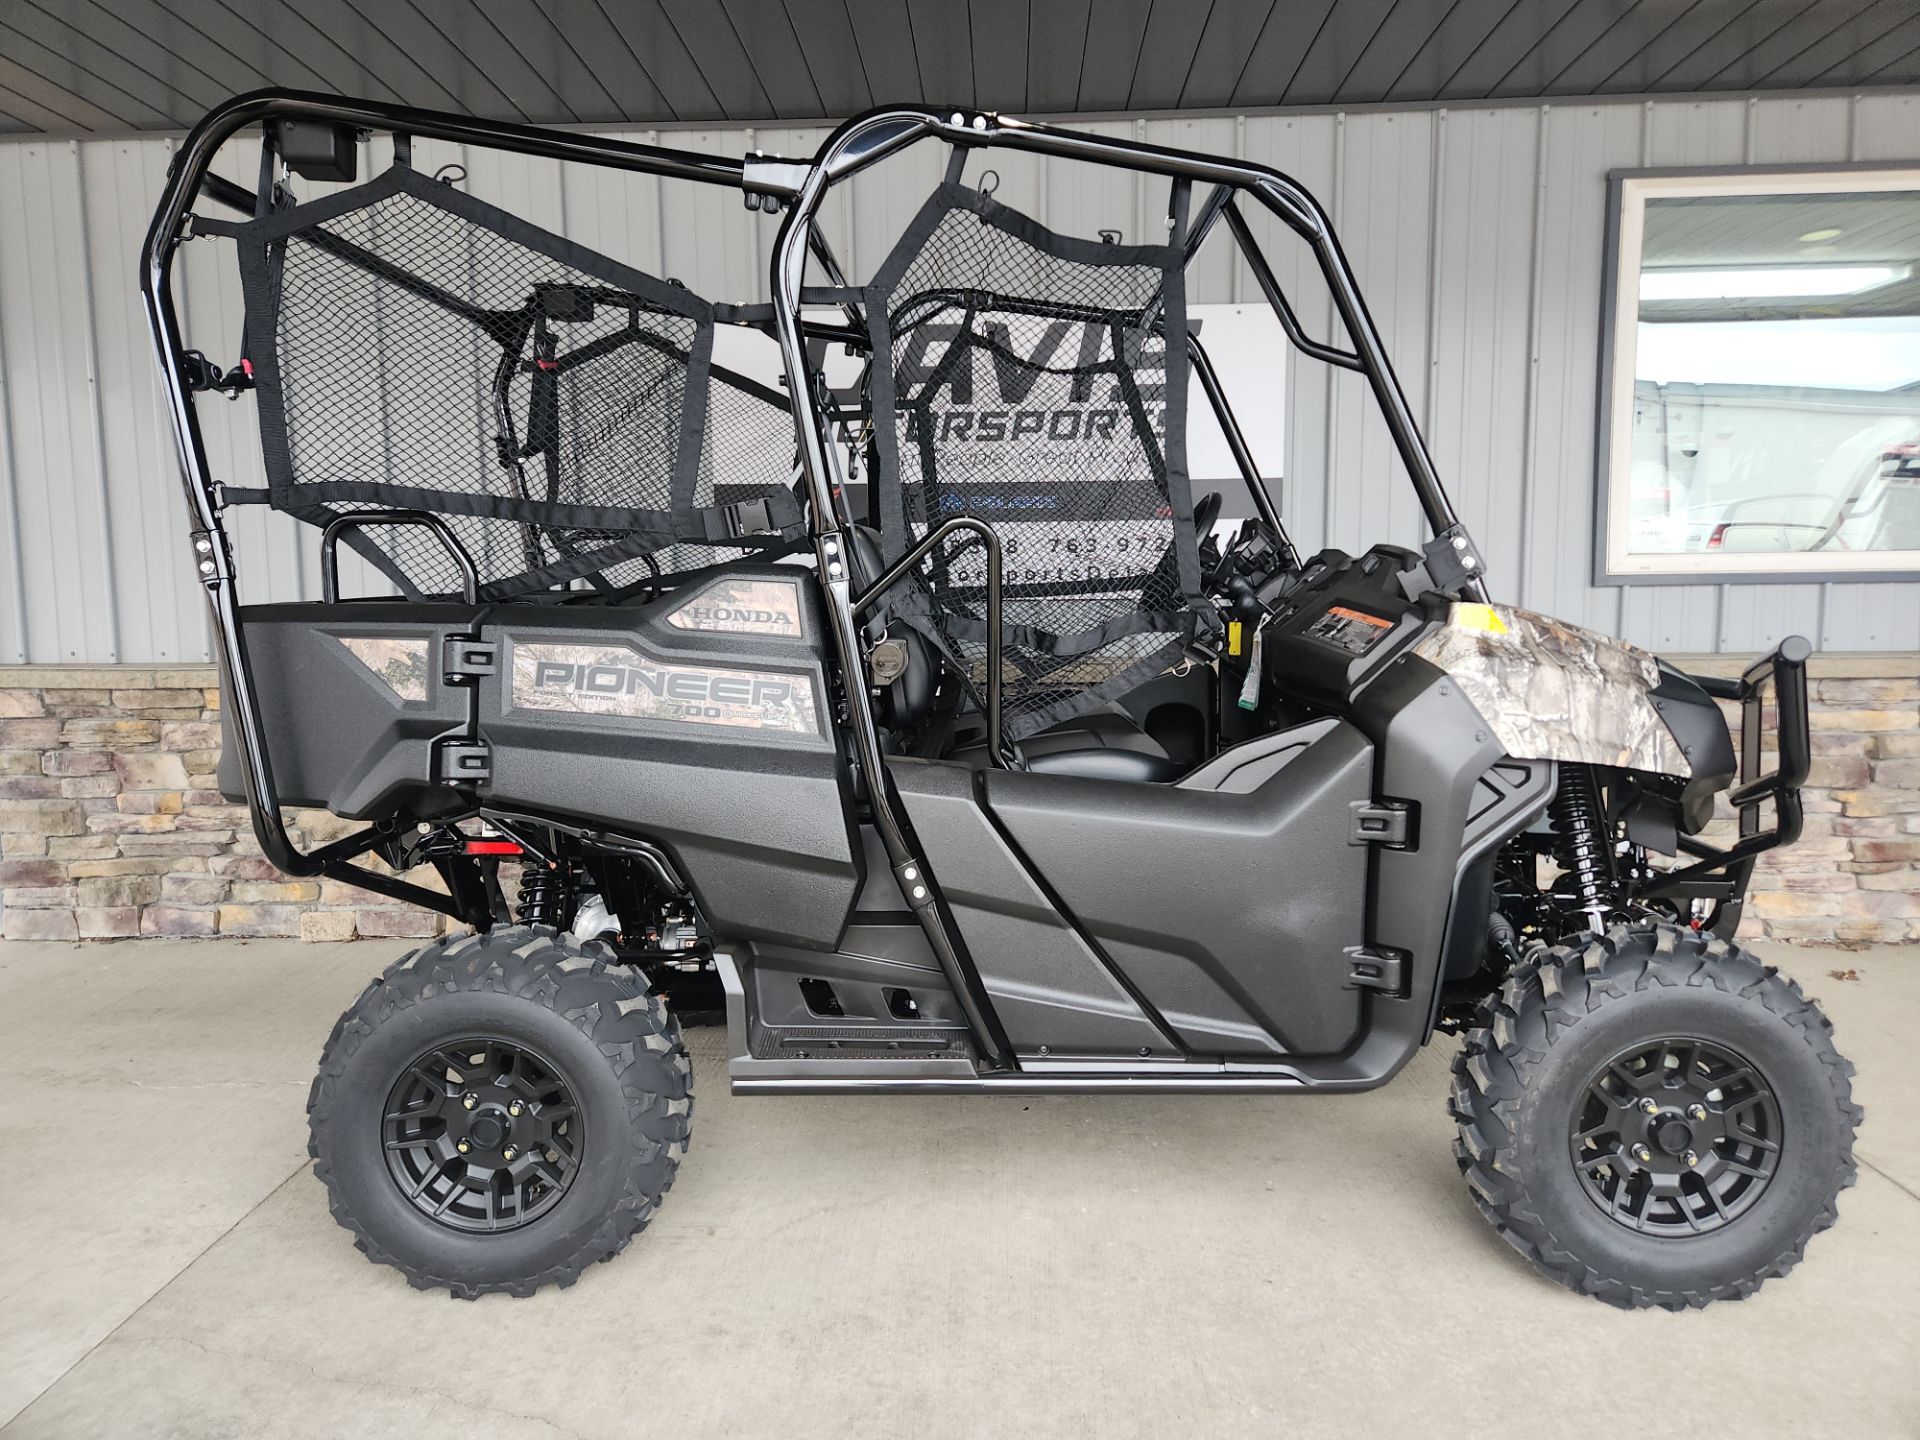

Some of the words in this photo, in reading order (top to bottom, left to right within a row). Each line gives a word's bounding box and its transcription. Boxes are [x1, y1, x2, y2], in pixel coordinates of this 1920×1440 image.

[793, 410, 1168, 442] OORSPORT
[692, 607, 793, 624] HONDA
[534, 661, 792, 707] PIONEER
[533, 690, 573, 699] FOREST
[578, 693, 617, 702] EDITION
[667, 704, 721, 718] 700
